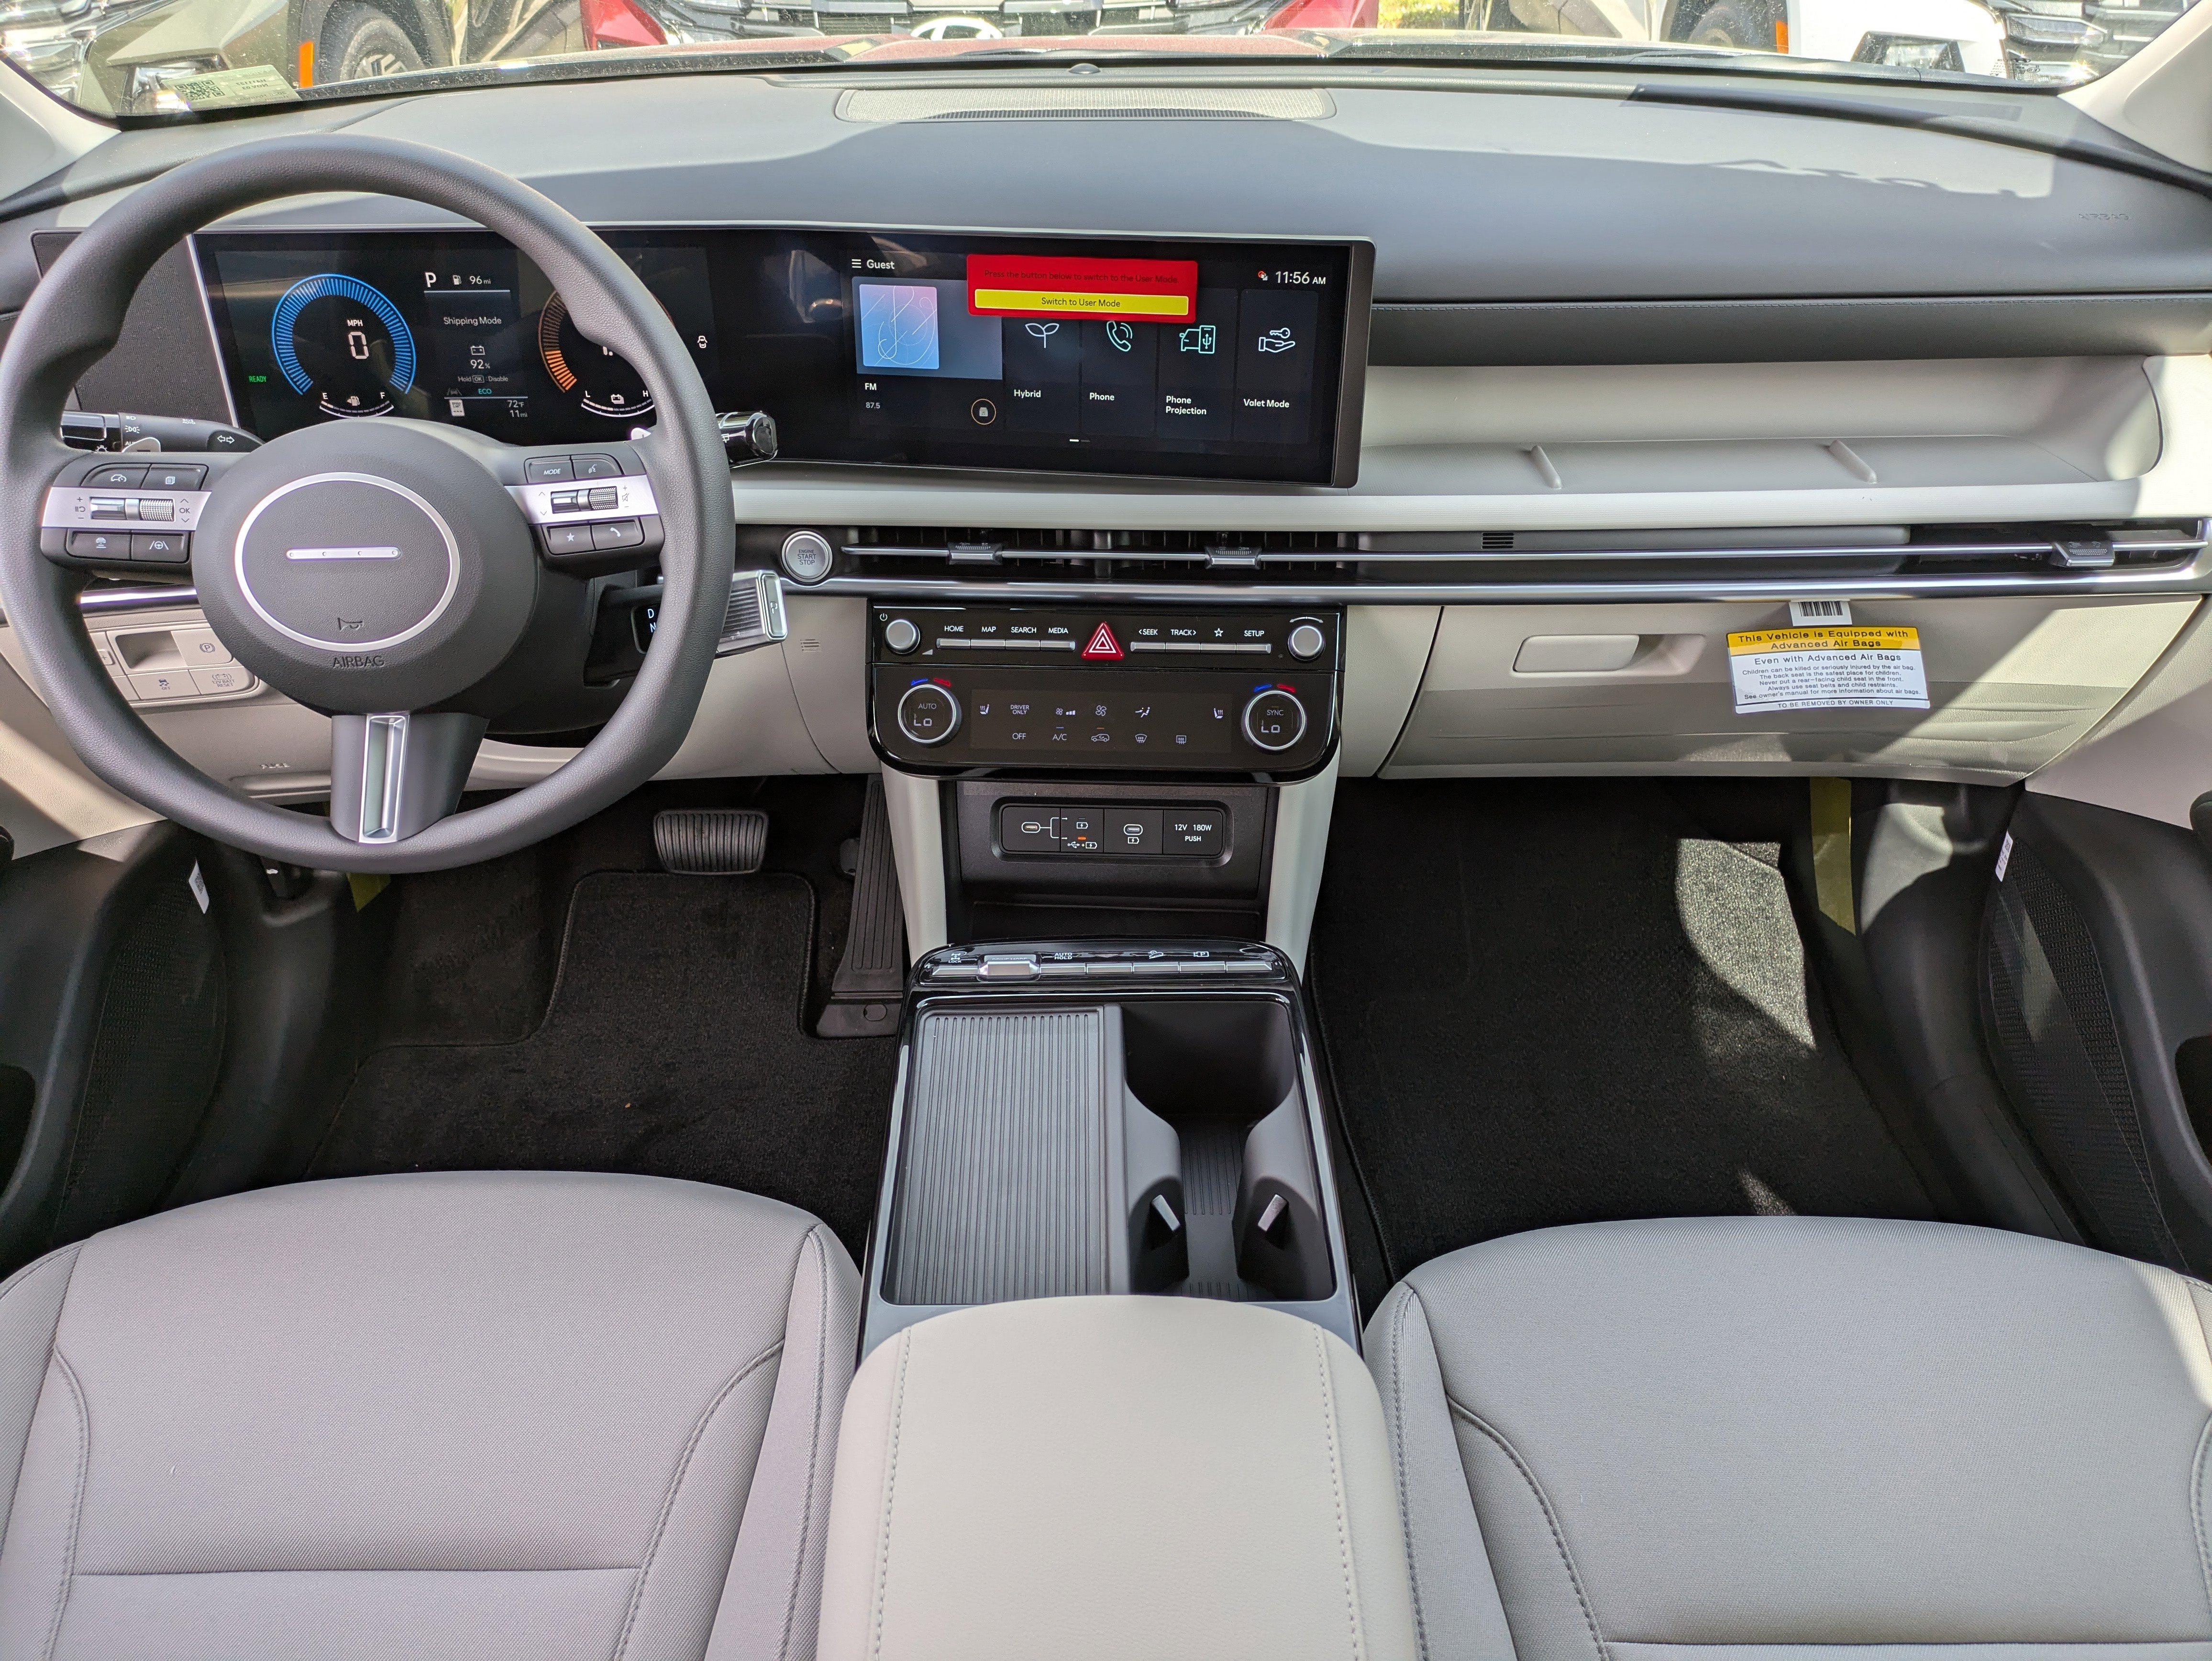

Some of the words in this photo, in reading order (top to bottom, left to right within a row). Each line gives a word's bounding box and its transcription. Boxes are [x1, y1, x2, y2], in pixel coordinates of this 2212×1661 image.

[866, 259, 895, 270] Guest
[424, 272, 437, 288] P
[469, 276, 482, 284] 96
[1135, 275, 1153, 283] User
[1275, 271, 1310, 284] 11:56
[1041, 297, 1067, 305] Switch
[1098, 299, 1120, 307] Mode
[443, 317, 478, 326] Shipping
[348, 332, 369, 359] 0
[865, 383, 877, 391] FM
[1014, 389, 1041, 399] Hybrid
[1089, 392, 1115, 401] Phone
[1166, 396, 1191, 404] Phone
[1243, 399, 1265, 407] Valet
[1266, 399, 1290, 408] Mode
[1166, 406, 1207, 415] Projection
[647, 609, 654, 619] D
[650, 622, 656, 633] N
[1766, 631, 1809, 640] Vehicle
[1828, 630, 1882, 638] Equipped
[1771, 641, 1828, 650] Advanced
[332, 655, 385, 668] AIRBAG
[1808, 653, 1856, 662] Advanced
